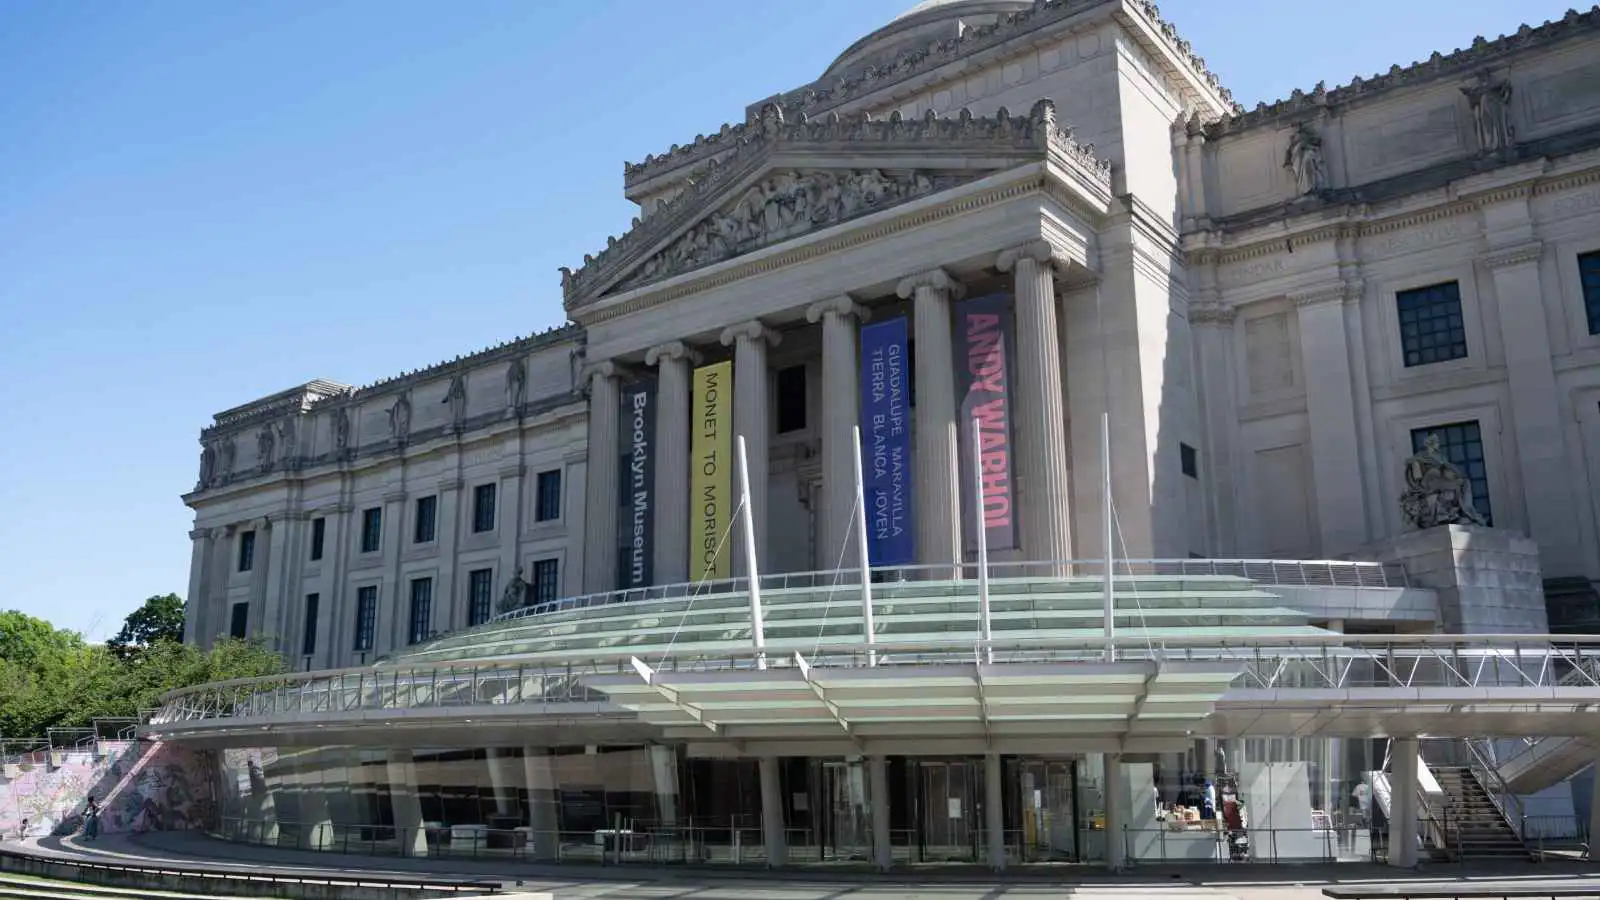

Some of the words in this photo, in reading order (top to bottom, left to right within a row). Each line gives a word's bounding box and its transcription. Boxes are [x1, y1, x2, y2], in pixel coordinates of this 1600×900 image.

[871, 347, 885, 404] TIERRA
[887, 343, 903, 437] GUADALUPE
[966, 313, 1004, 393] ANDY
[631, 391, 647, 487] Brooklyn
[703, 371, 719, 441] MONET
[703, 450, 717, 477] TO
[872, 414, 888, 480] BLANCA
[703, 484, 717, 577] MORISOT
[873, 490, 889, 541] JOVEN
[890, 446, 904, 538] MARAVILLA
[632, 490, 648, 584] Museum
